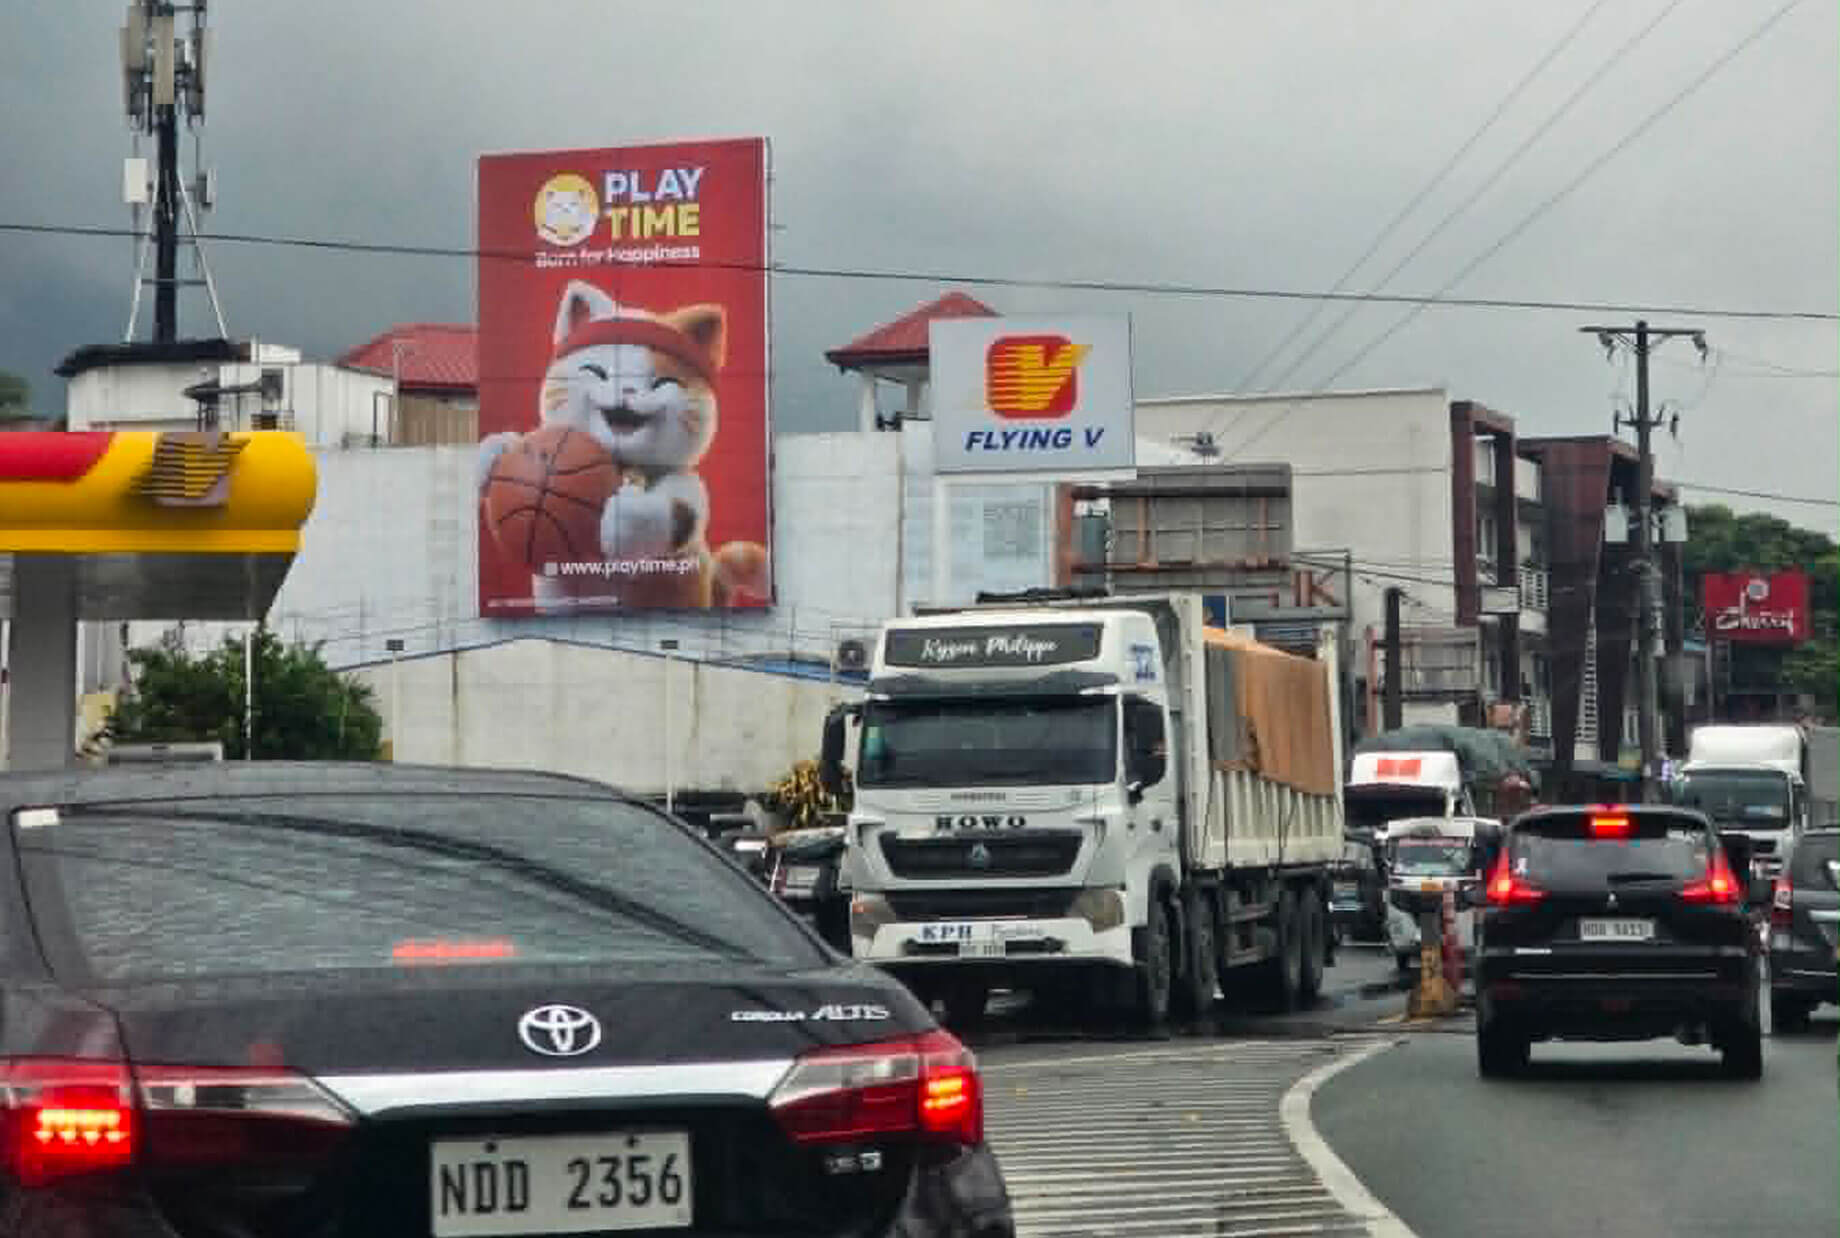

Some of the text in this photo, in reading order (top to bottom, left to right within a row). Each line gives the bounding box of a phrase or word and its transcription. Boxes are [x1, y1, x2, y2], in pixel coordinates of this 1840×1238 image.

[605, 168, 704, 203] PLAY
[604, 202, 700, 239] TIME
[964, 427, 1105, 451] FLYING V
[935, 815, 1027, 830] HOWO
[921, 925, 973, 940] KPH
[811, 1003, 891, 1021] ALTIS
[440, 1152, 683, 1217] NDD 2356
